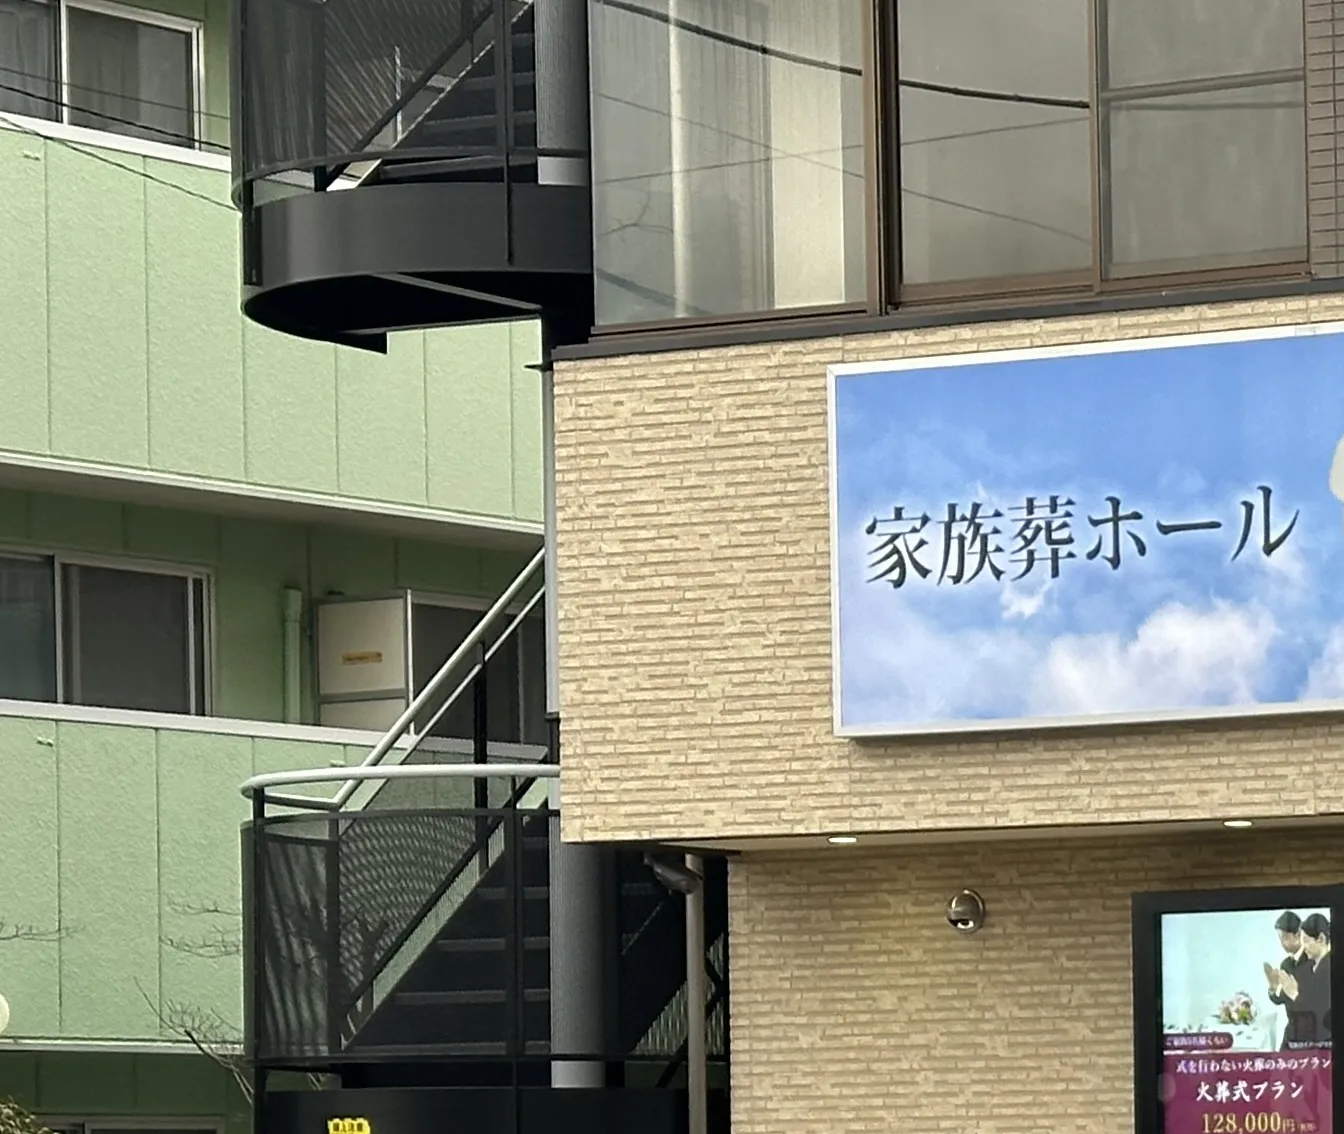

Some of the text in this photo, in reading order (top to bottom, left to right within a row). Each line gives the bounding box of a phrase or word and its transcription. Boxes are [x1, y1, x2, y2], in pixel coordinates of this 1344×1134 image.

[864, 485, 1299, 590] 家族葬ホール
[1195, 1080, 1304, 1103] 火葬式プラン
